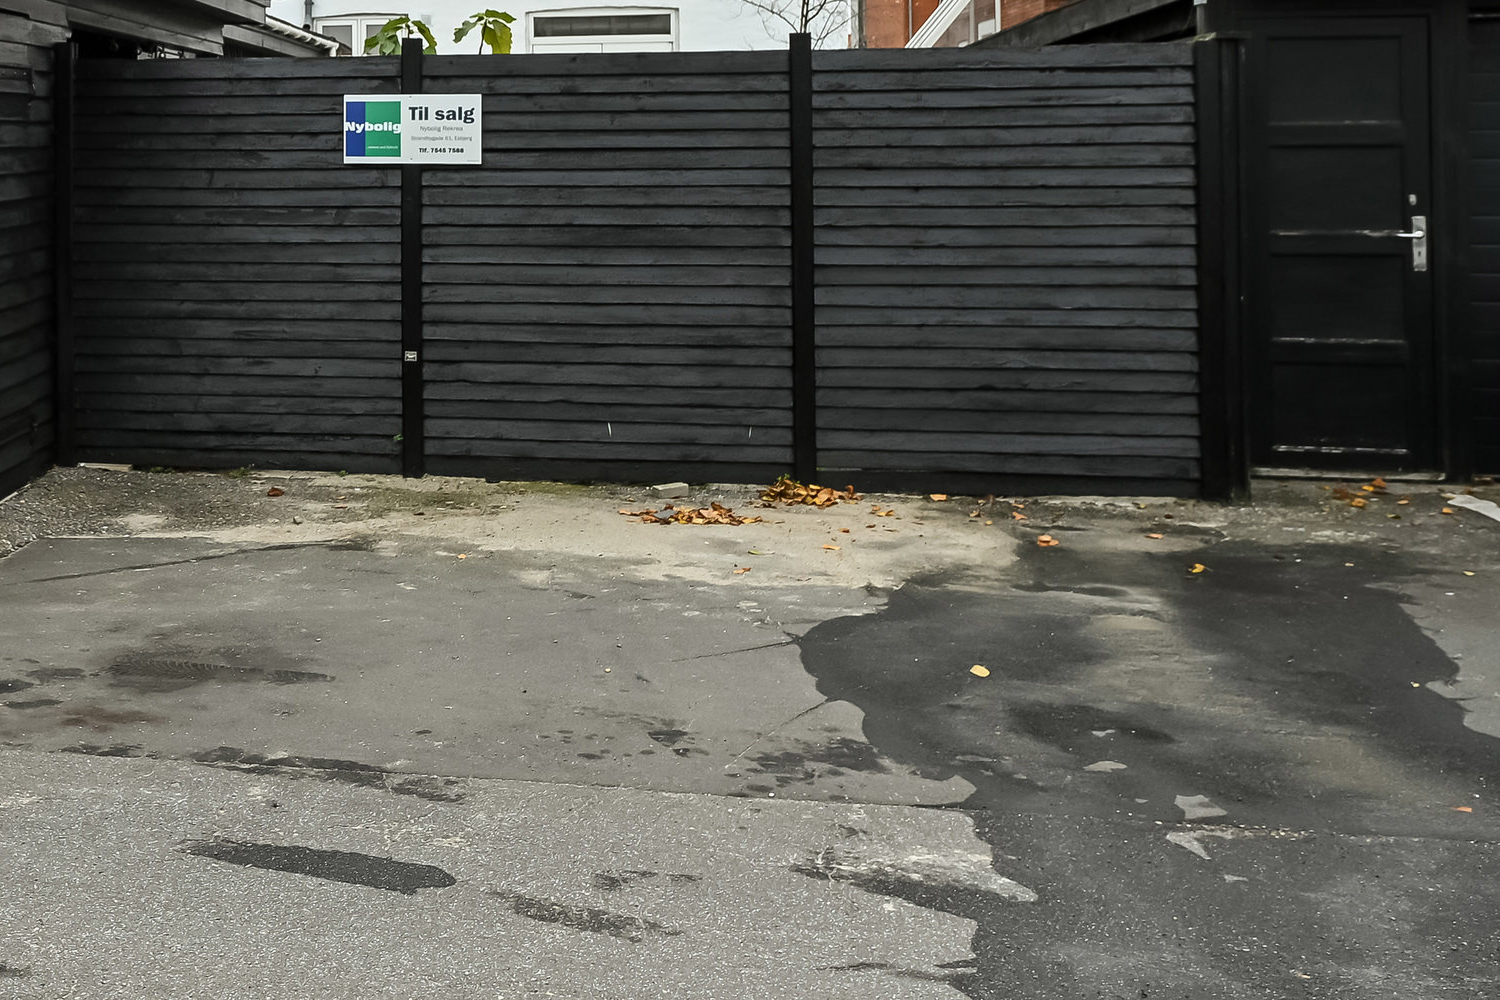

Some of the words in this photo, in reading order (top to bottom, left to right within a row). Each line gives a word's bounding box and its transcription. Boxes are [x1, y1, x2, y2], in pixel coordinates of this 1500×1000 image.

[409, 106, 429, 121] Til
[435, 106, 475, 124] salg
[345, 121, 402, 134] Nybolig
[419, 125, 442, 133] Nybolig
